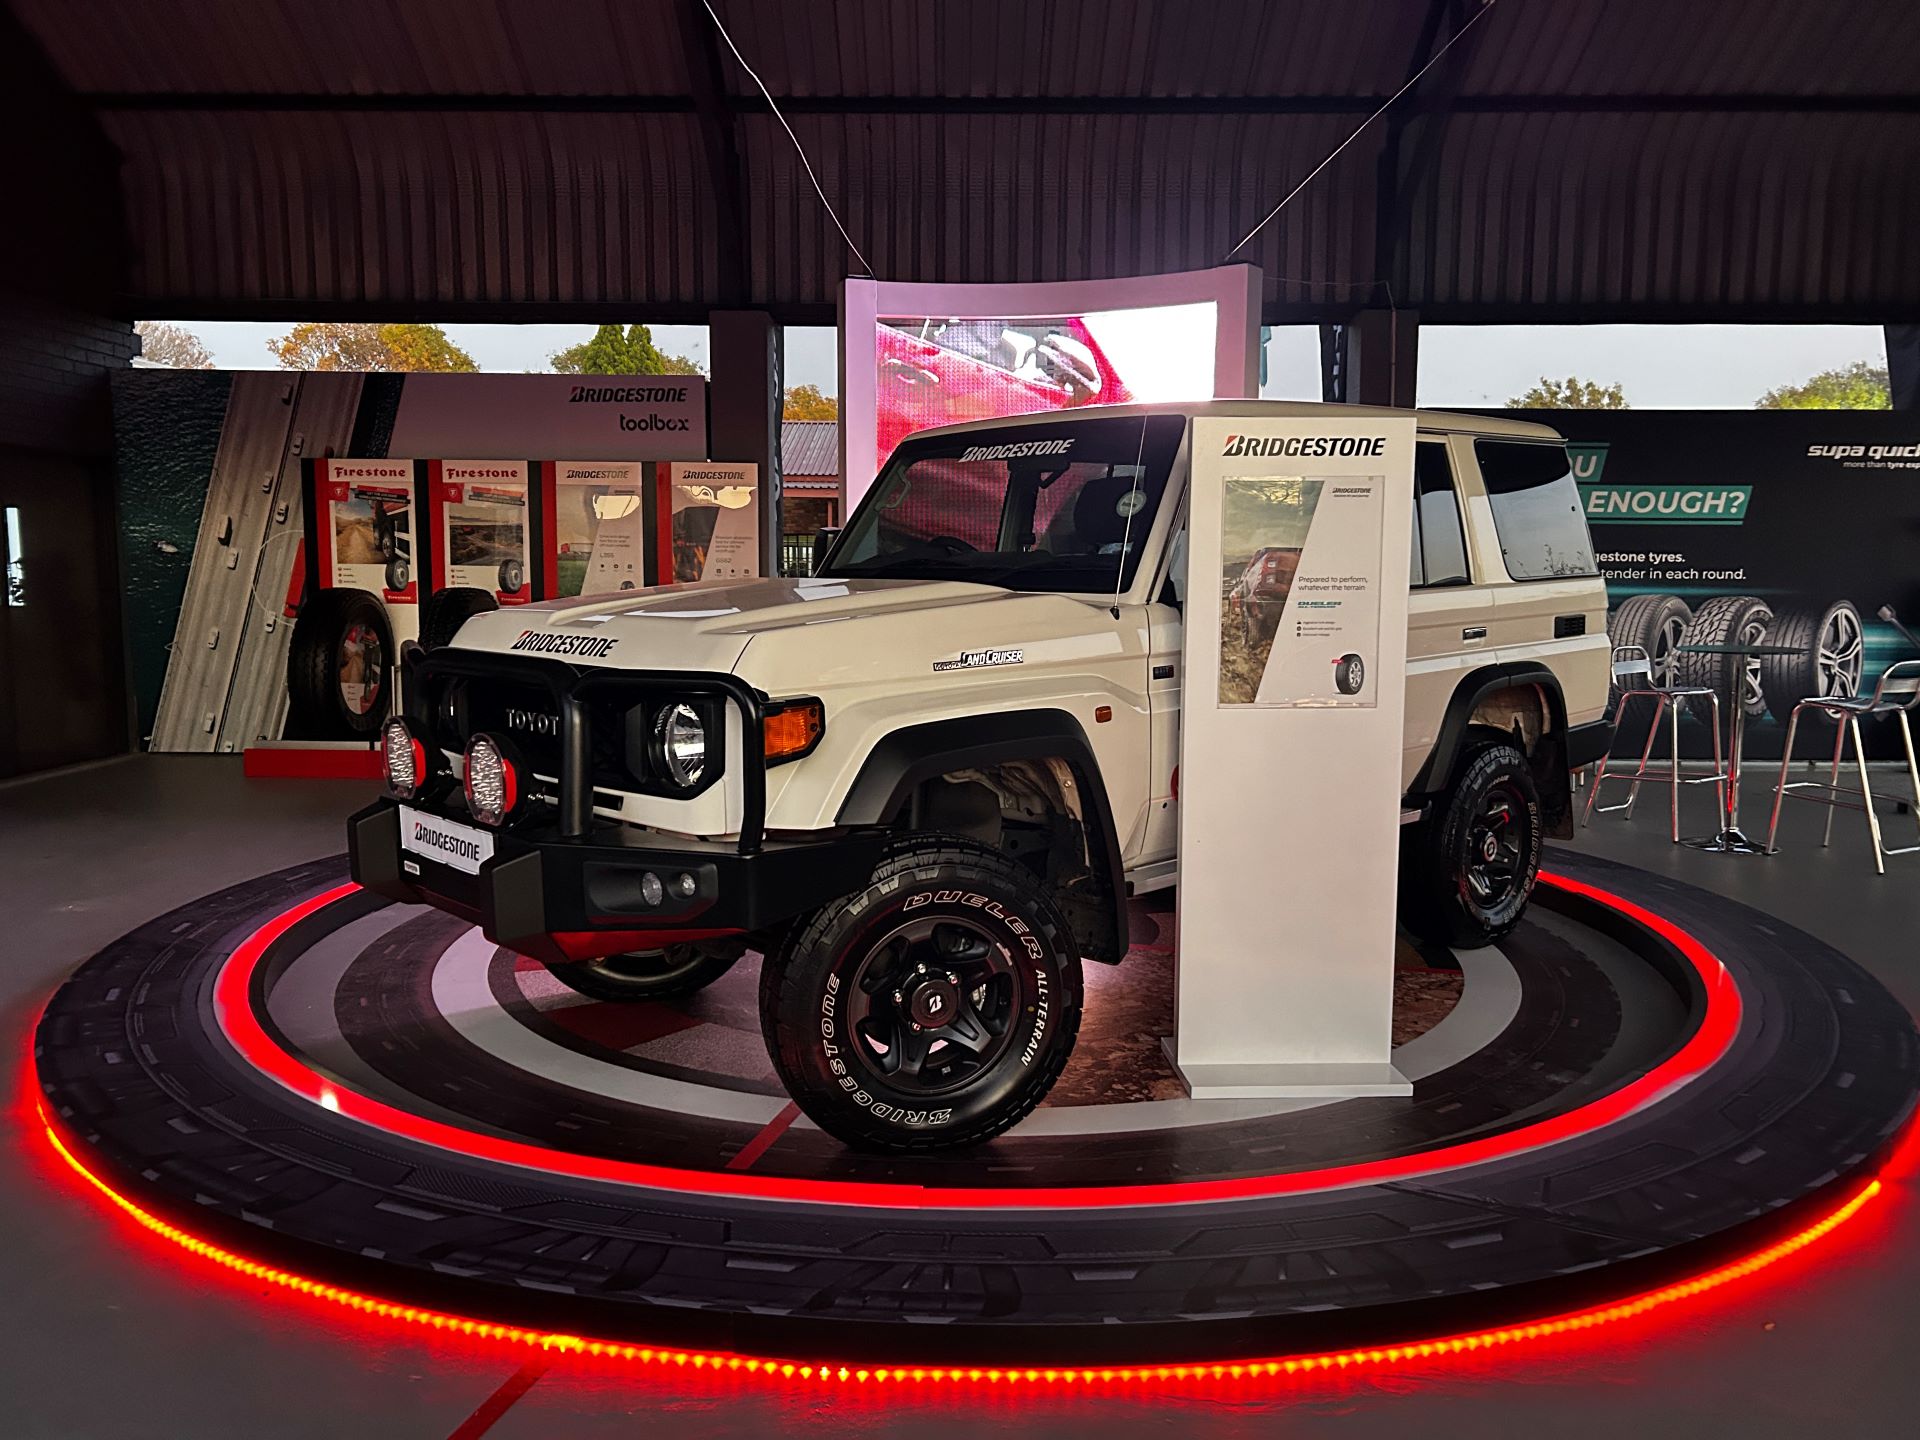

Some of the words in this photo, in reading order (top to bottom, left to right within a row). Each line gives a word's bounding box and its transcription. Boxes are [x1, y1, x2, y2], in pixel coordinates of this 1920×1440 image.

[569, 386, 689, 402] BRIDGESTONE
[620, 413, 690, 431] toolbox
[958, 438, 1076, 463] BRIDGESTONE
[1222, 435, 1387, 457] BRIDGESTONE
[1807, 445, 1866, 459] supa
[334, 466, 406, 478] Firestone
[1887, 461, 1905, 469] tyre
[446, 468, 518, 479] Firestone
[566, 469, 630, 479] BRIDGESTONE
[682, 470, 746, 480] BRIDGESTONE
[1587, 491, 1745, 513] ENOUGH?
[1648, 552, 1686, 564] tyres.
[1298, 576, 1330, 584] Prepared
[1339, 576, 1368, 584] perform,
[1649, 568, 1662, 579] in
[1666, 568, 1698, 579] each
[1702, 568, 1746, 579] round.
[510, 630, 620, 658] BRIDGESTONE
[505, 708, 559, 735] TOYOT
[415, 822, 480, 862] BRIDGESTONE
[903, 890, 1043, 960] DUELER
[821, 972, 953, 1126] BRIDGESTONE
